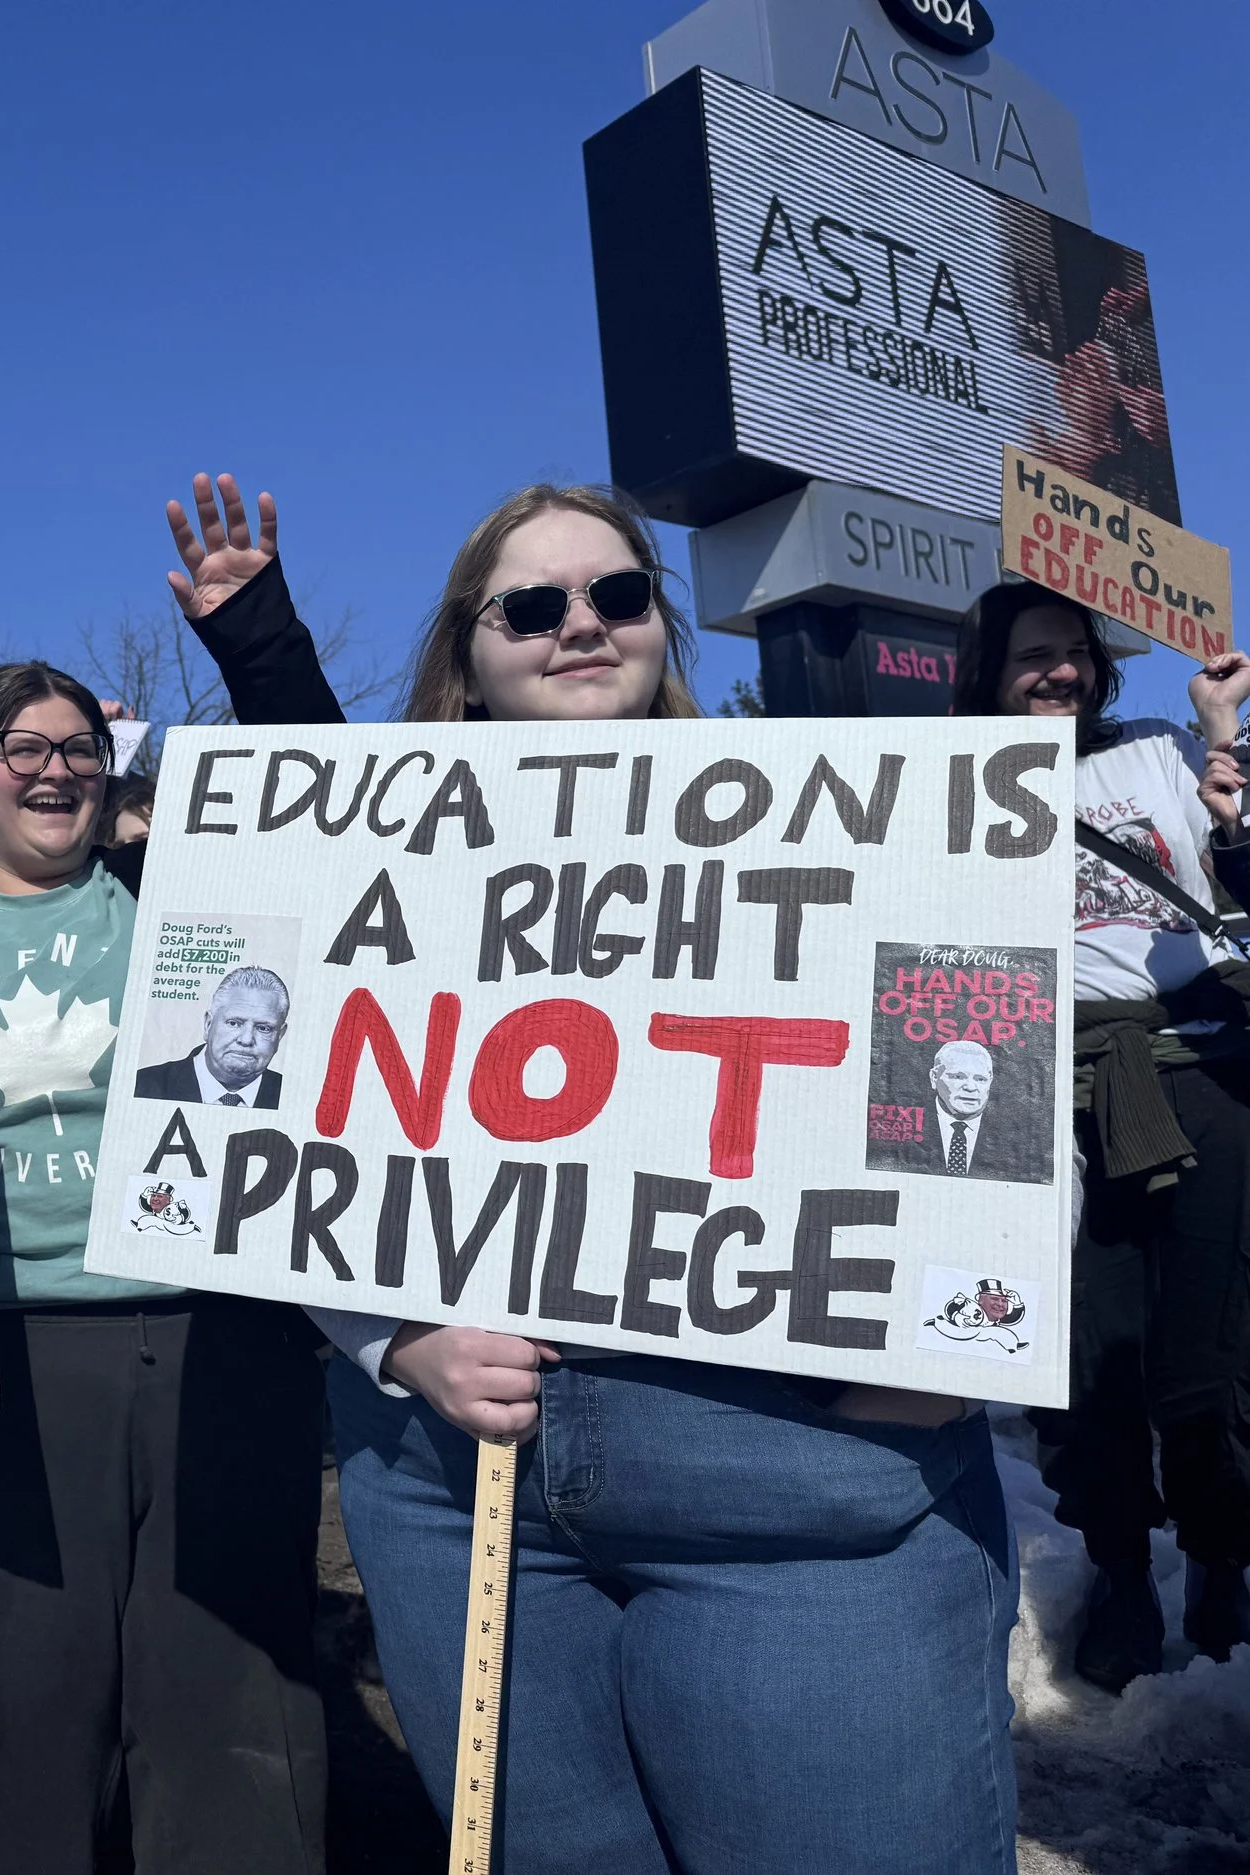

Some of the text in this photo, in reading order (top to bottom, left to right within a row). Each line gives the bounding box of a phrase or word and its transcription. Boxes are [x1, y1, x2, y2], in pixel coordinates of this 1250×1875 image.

[829, 25, 1047, 194] ASTA
[752, 194, 980, 351] ASTA
[757, 289, 990, 415] PROFESSIONAL
[1016, 459, 1155, 558] Hands
[842, 510, 975, 591] SPIRIT
[1032, 512, 1104, 566] OFF
[1131, 560, 1216, 619] Our
[1020, 534, 1226, 658] EDUCATION
[876, 641, 940, 683] Asta
[184, 741, 1061, 859] EDUCATION IS
[161, 922, 232, 935] Doug Ford's
[323, 859, 855, 983] A RIGHT
[159, 935, 245, 949] OSAP cuts will
[157, 949, 240, 962] add $7,200 in
[919, 948, 959, 965] DEAR
[155, 962, 226, 975] debt for the
[153, 977, 201, 989] average
[895, 967, 1039, 997] HANDS
[150, 989, 200, 1001] student.
[879, 991, 1055, 1024] OFF OUR
[903, 1016, 1027, 1048] OSAP.
[315, 987, 851, 1180] NOT
[143, 1107, 900, 1351] A PRIVILEGE
[491, 1469, 501, 1482] 22
[489, 1507, 498, 1520] 23
[486, 1543, 495, 1557] 24
[484, 1582, 493, 1596] 25
[481, 1620, 490, 1634] 26
[478, 1658, 488, 1673] 27
[475, 1698, 485, 1712] 28
[473, 1738, 482, 1752] 29
[470, 1776, 479, 1792] 30
[467, 1817, 476, 1831] 31
[464, 1858, 473, 1873] 32
